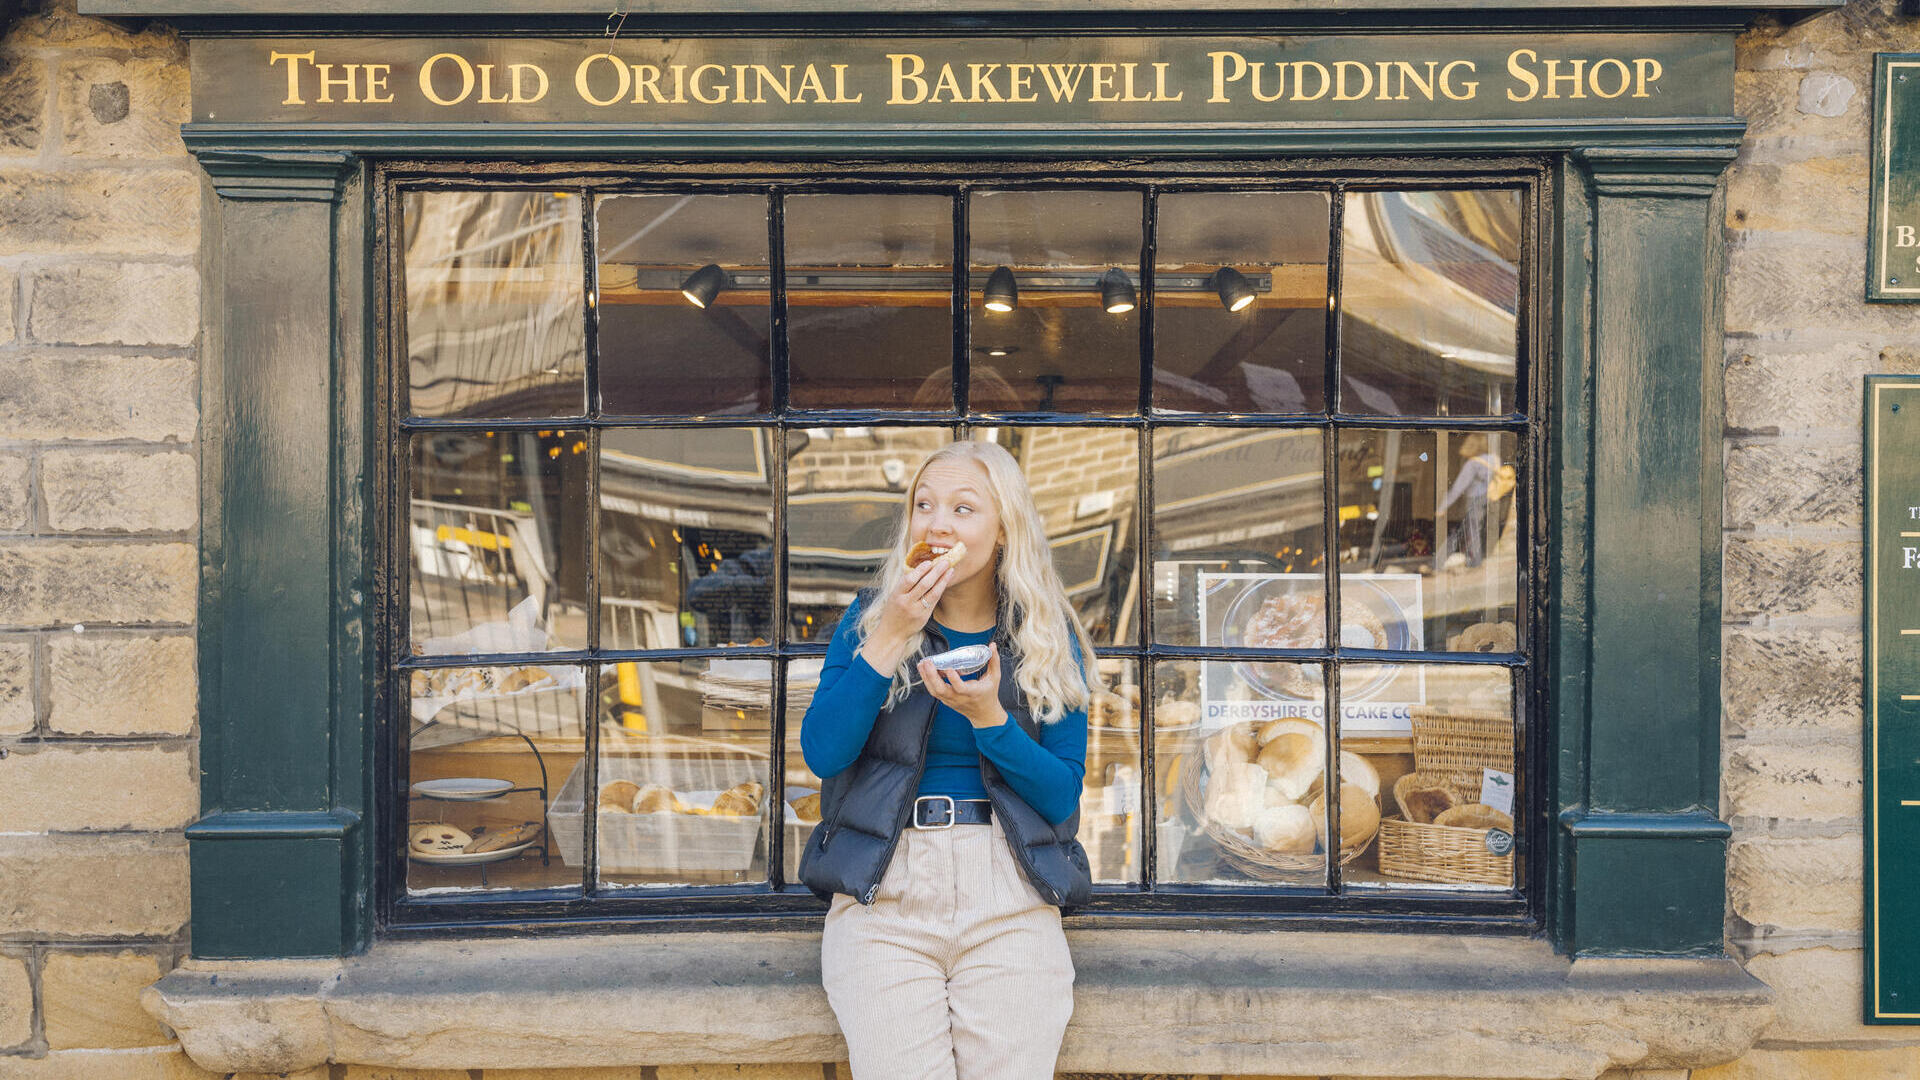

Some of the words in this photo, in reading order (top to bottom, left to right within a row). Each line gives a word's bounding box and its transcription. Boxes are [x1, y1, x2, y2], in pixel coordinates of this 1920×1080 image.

[270, 50, 395, 105] THE
[418, 53, 549, 106] OLD
[574, 53, 863, 106] ORIGINAL
[886, 53, 1183, 104] BAKEWELL
[1208, 51, 1479, 103] PUDDING
[1507, 48, 1663, 102] SHOP
[1895, 226, 1920, 248] B
[1208, 704, 1308, 719] DERBYSHIRE
[1311, 705, 1388, 719] OCAKE
